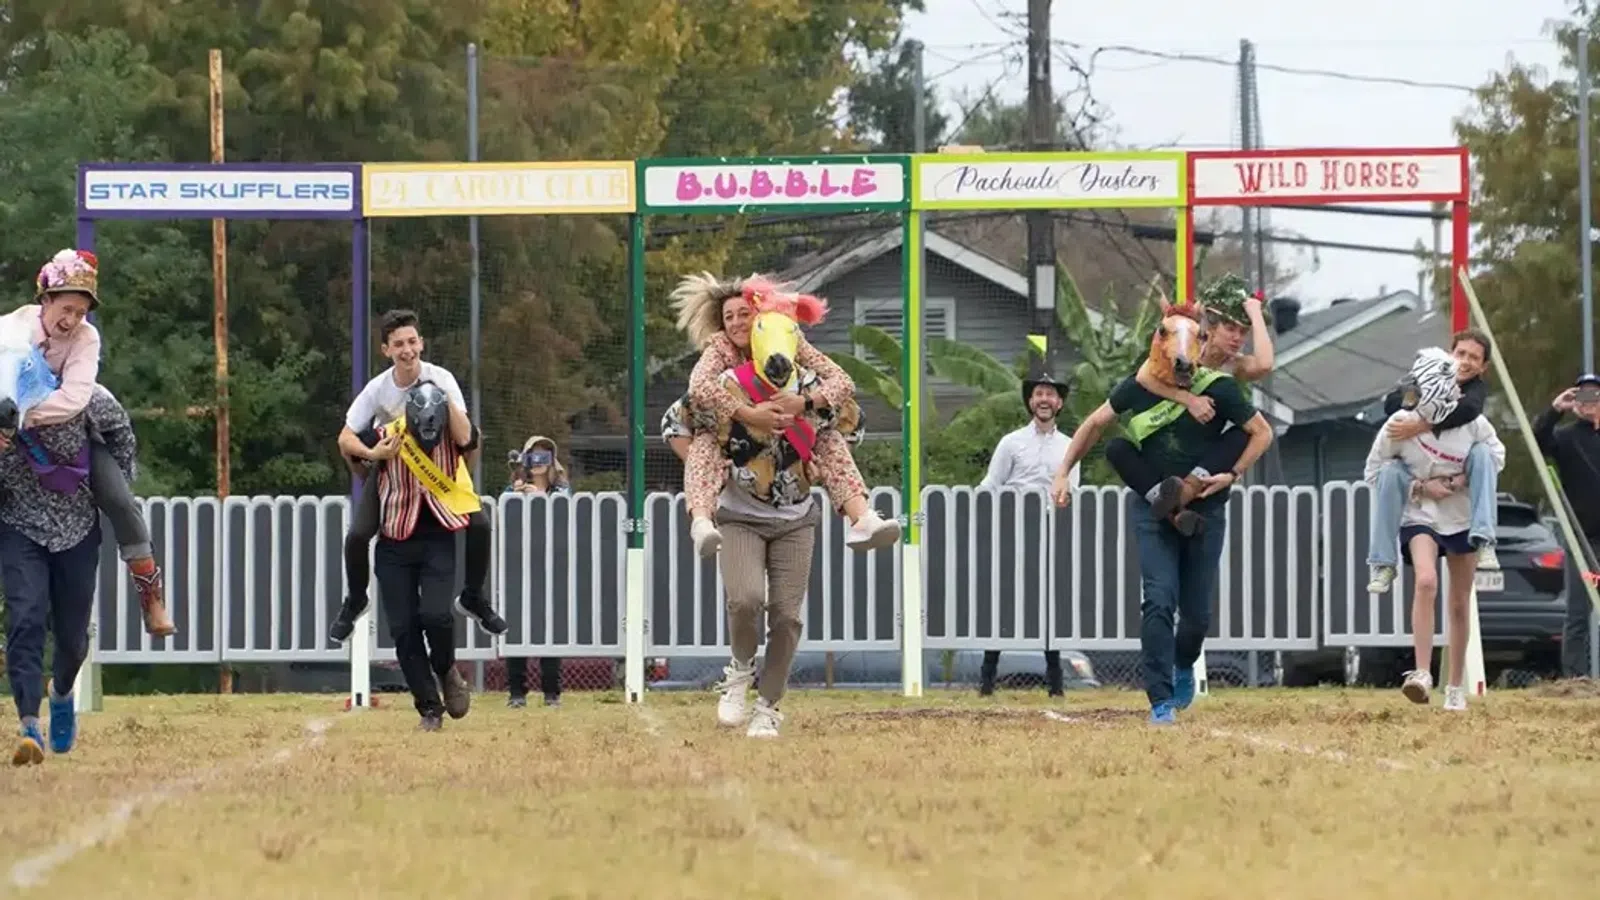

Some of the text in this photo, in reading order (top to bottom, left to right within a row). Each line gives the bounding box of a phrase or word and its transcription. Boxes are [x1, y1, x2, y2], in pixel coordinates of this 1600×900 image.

[89, 182, 350, 200] STAR SKUFFLERS
[374, 173, 626, 203] 24 CAROT CLUB
[676, 168, 877, 201] B.U.B.B.L.E
[1056, 163, 1160, 198] Dusters
[1234, 160, 1420, 194] WILD HORSES
